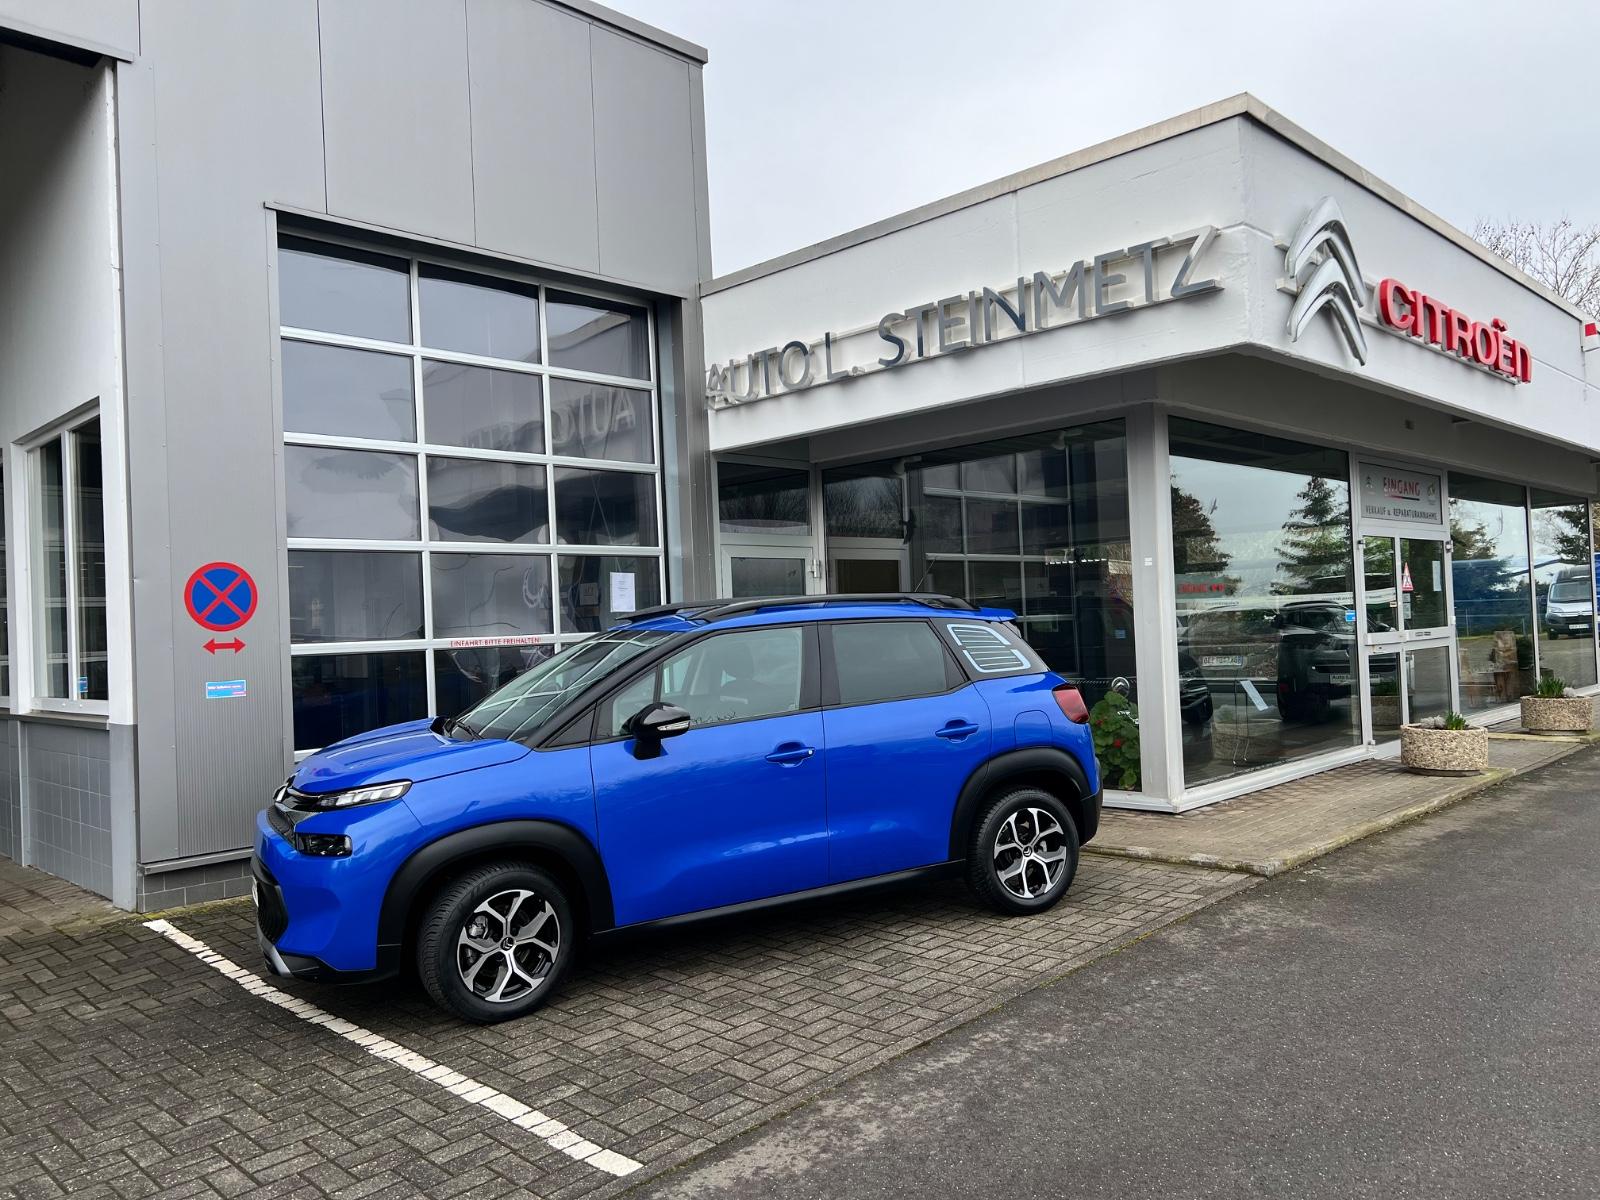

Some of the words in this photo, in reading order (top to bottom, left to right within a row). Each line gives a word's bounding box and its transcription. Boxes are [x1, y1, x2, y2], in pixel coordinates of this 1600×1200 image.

[706, 339, 814, 406] AUTO
[877, 225, 1224, 368] STEINMETZ
[1376, 278, 1532, 384] CITROËN
[1383, 476, 1421, 497] EINGANG
[450, 640, 482, 648] EINFAHRT
